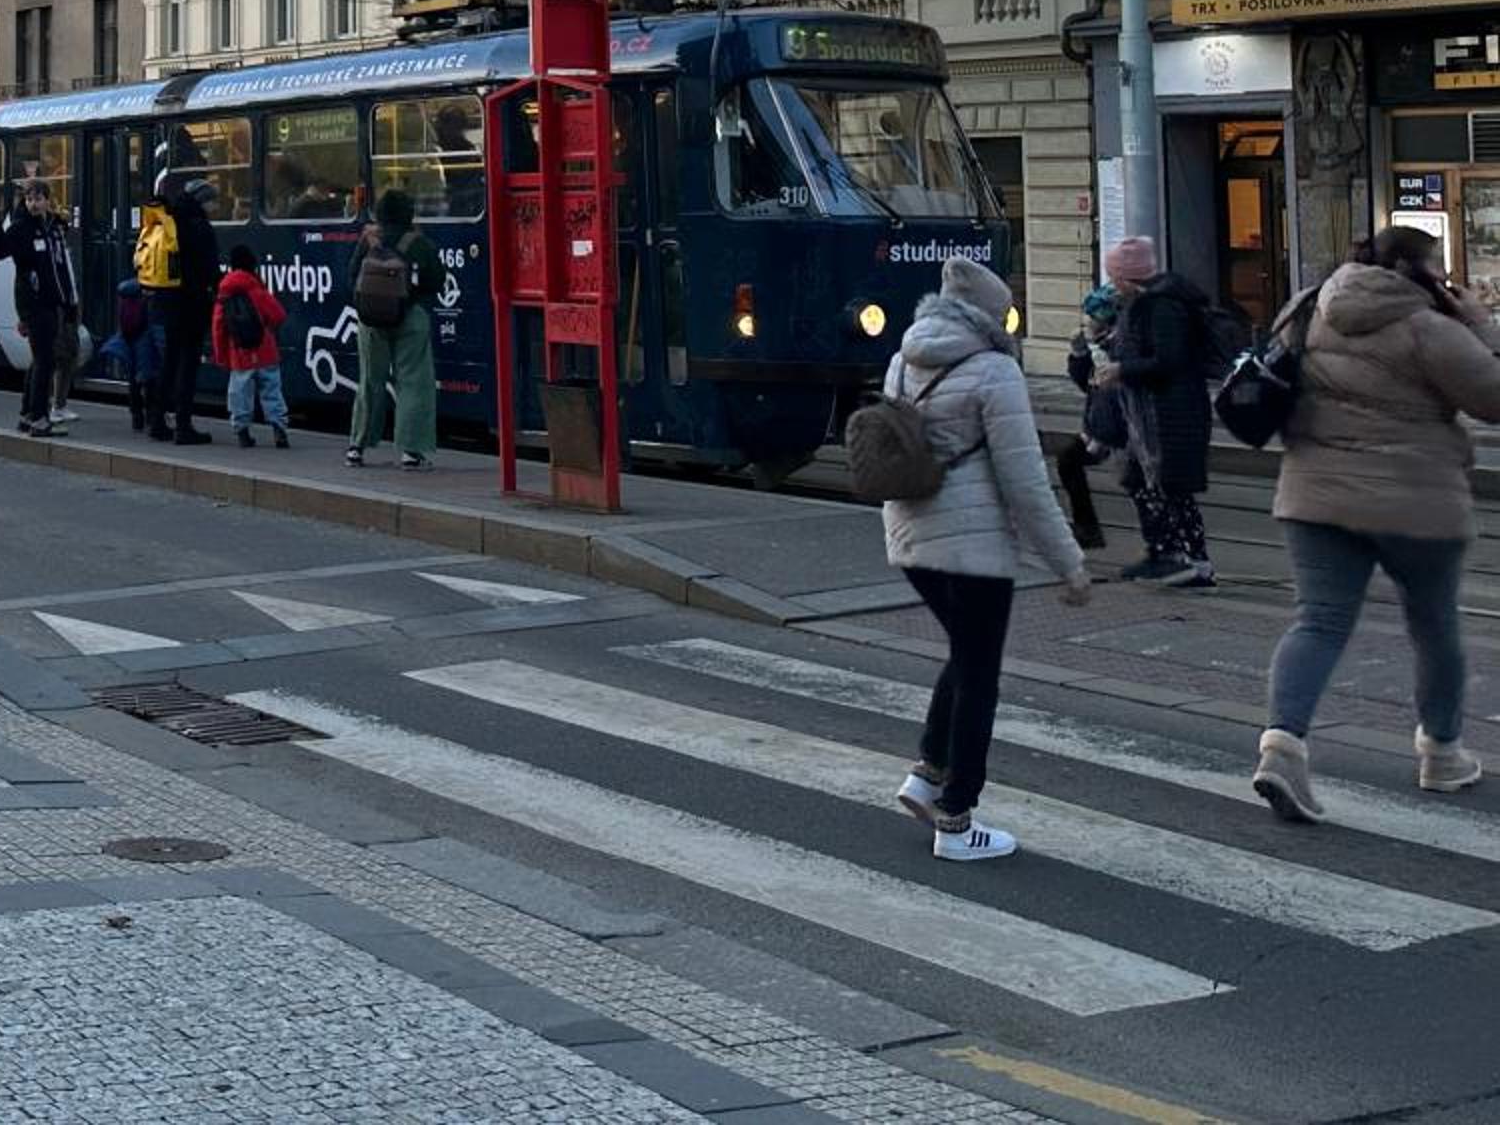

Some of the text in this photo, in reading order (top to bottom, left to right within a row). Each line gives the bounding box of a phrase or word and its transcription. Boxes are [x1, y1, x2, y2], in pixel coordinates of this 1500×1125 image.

[1190, 1, 1217, 16] TRX
[279, 68, 351, 90] TECHNICKÉ
[357, 54, 467, 80] ZAMĚSTNANCE
[1399, 178, 1423, 188] EUR
[779, 186, 809, 205] 310
[1399, 195, 1423, 206] CZK
